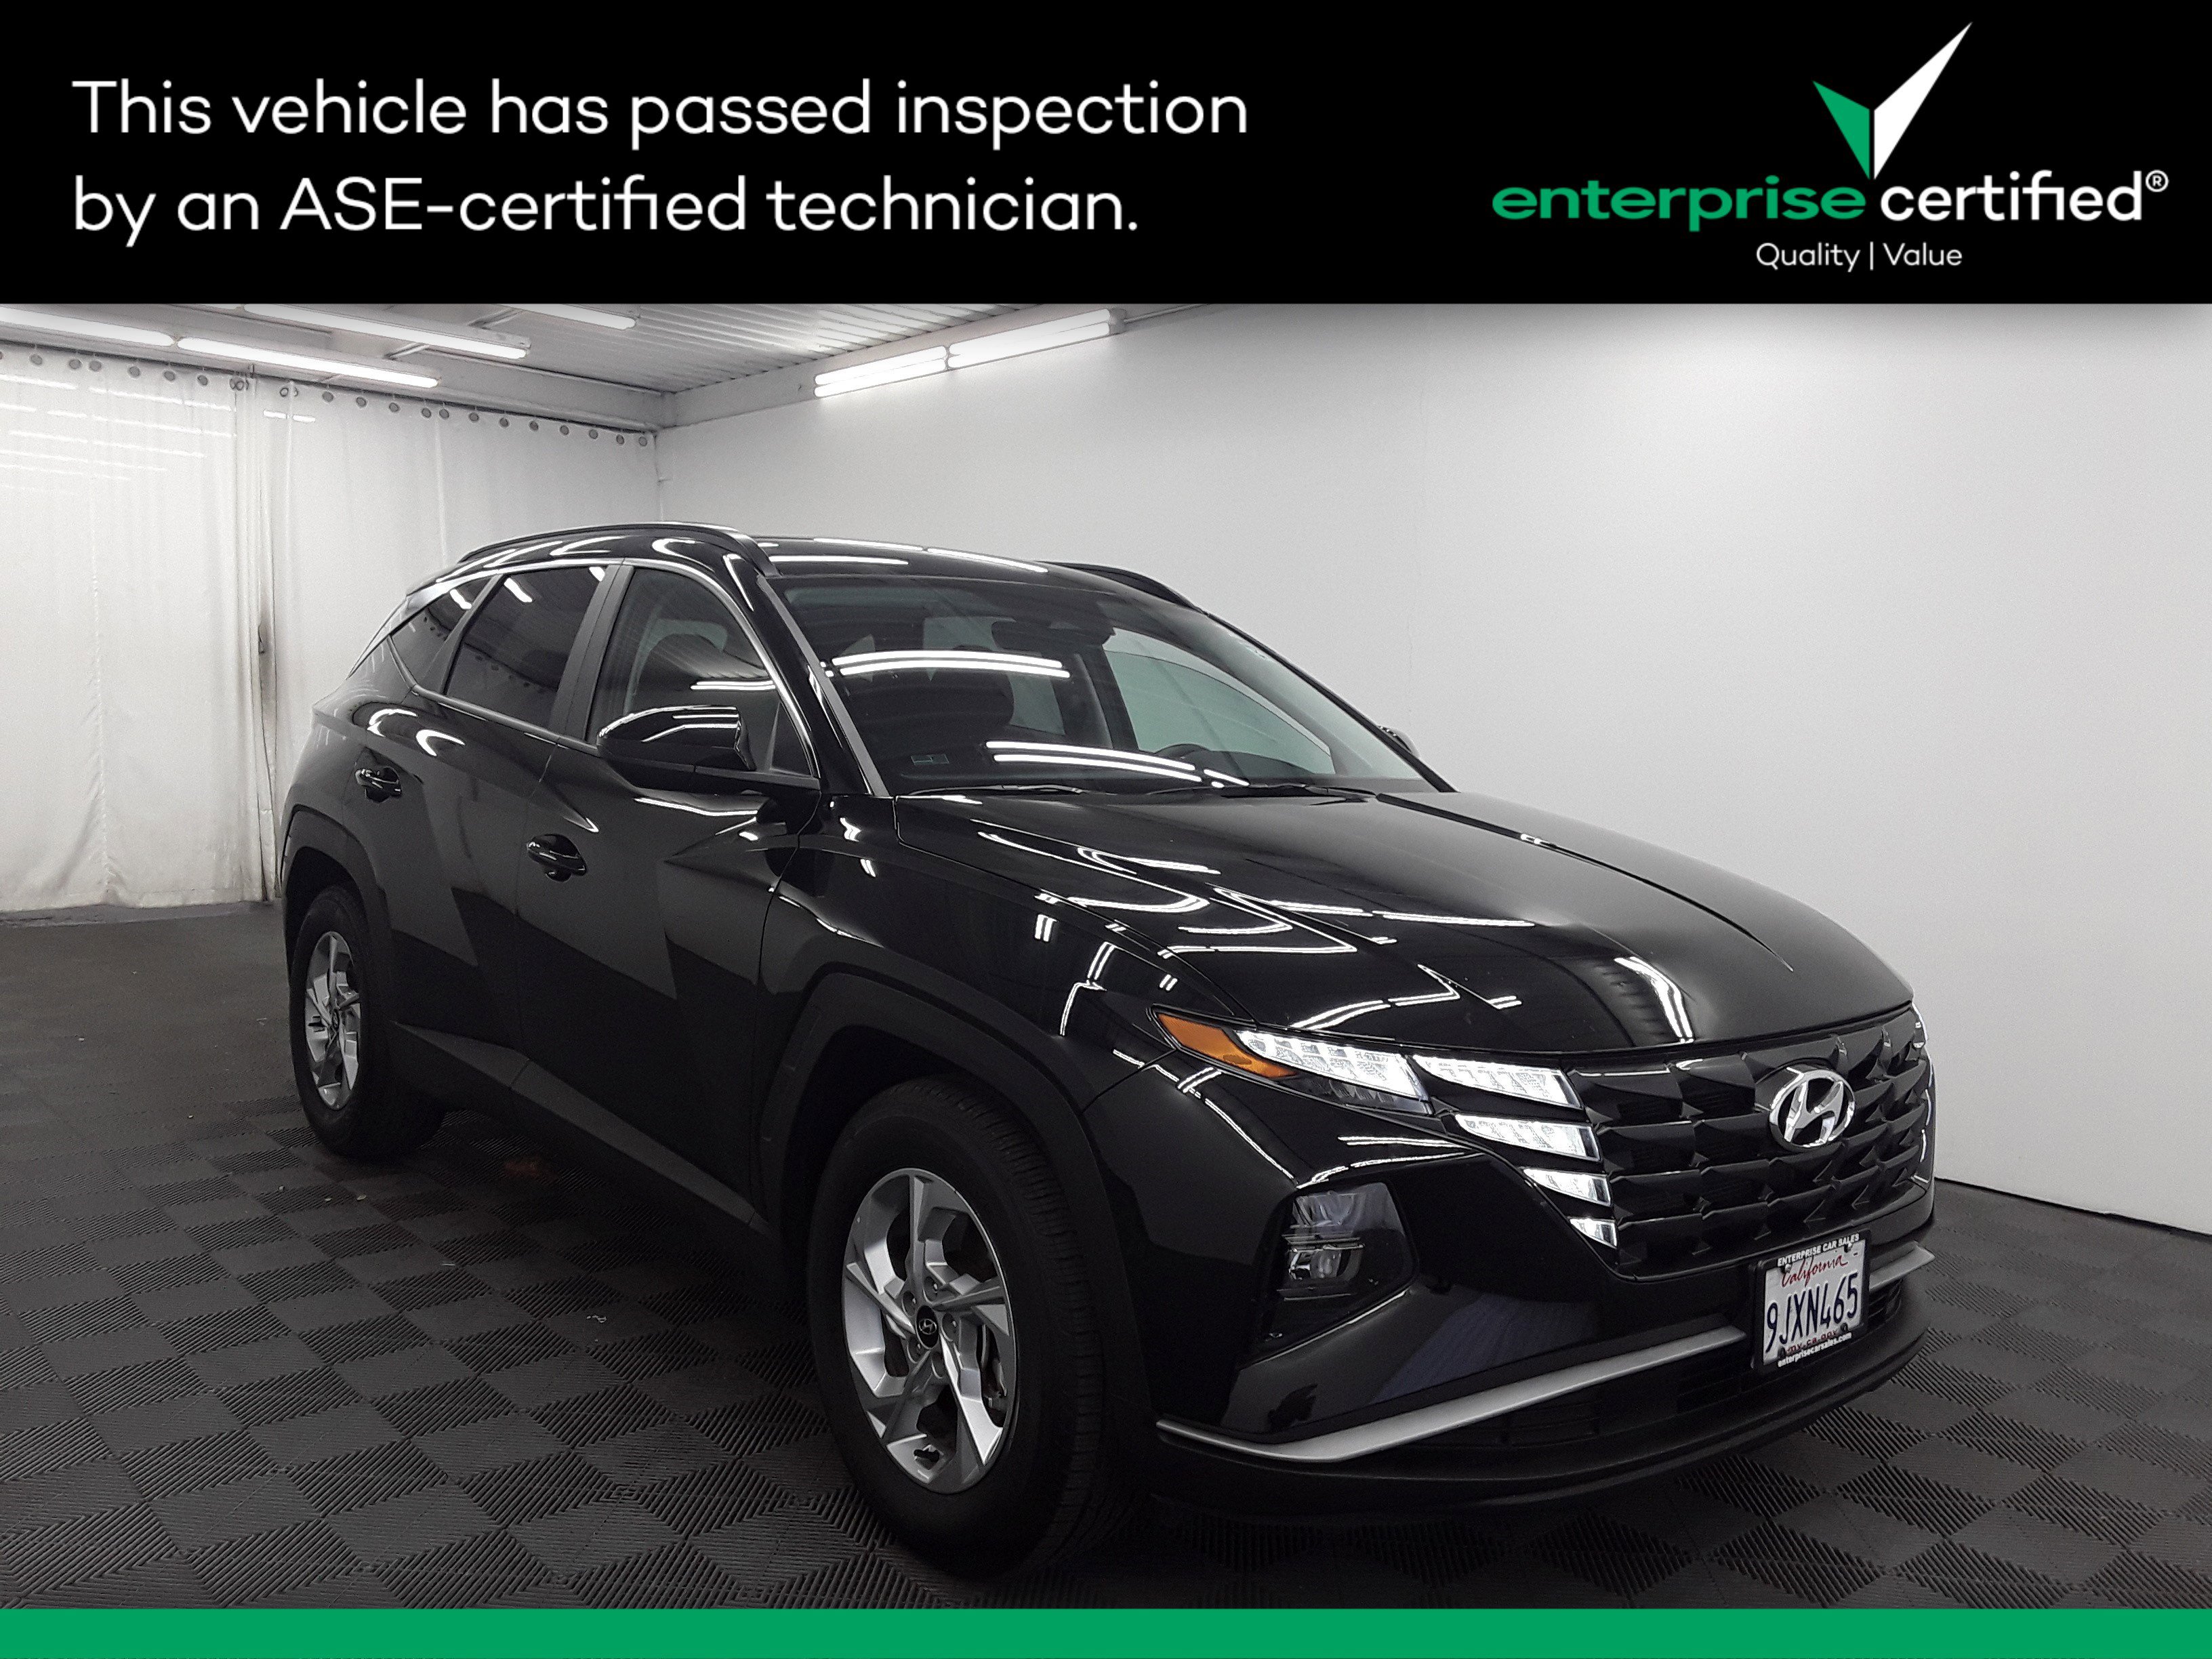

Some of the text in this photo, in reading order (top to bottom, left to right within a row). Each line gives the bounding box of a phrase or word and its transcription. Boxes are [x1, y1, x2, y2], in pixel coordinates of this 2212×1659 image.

[1778, 1233, 1860, 1267] ENTERPRISE CAR SALES
[1782, 1255, 1848, 1288] California
[1765, 1271, 1858, 1353] 9JXN465
